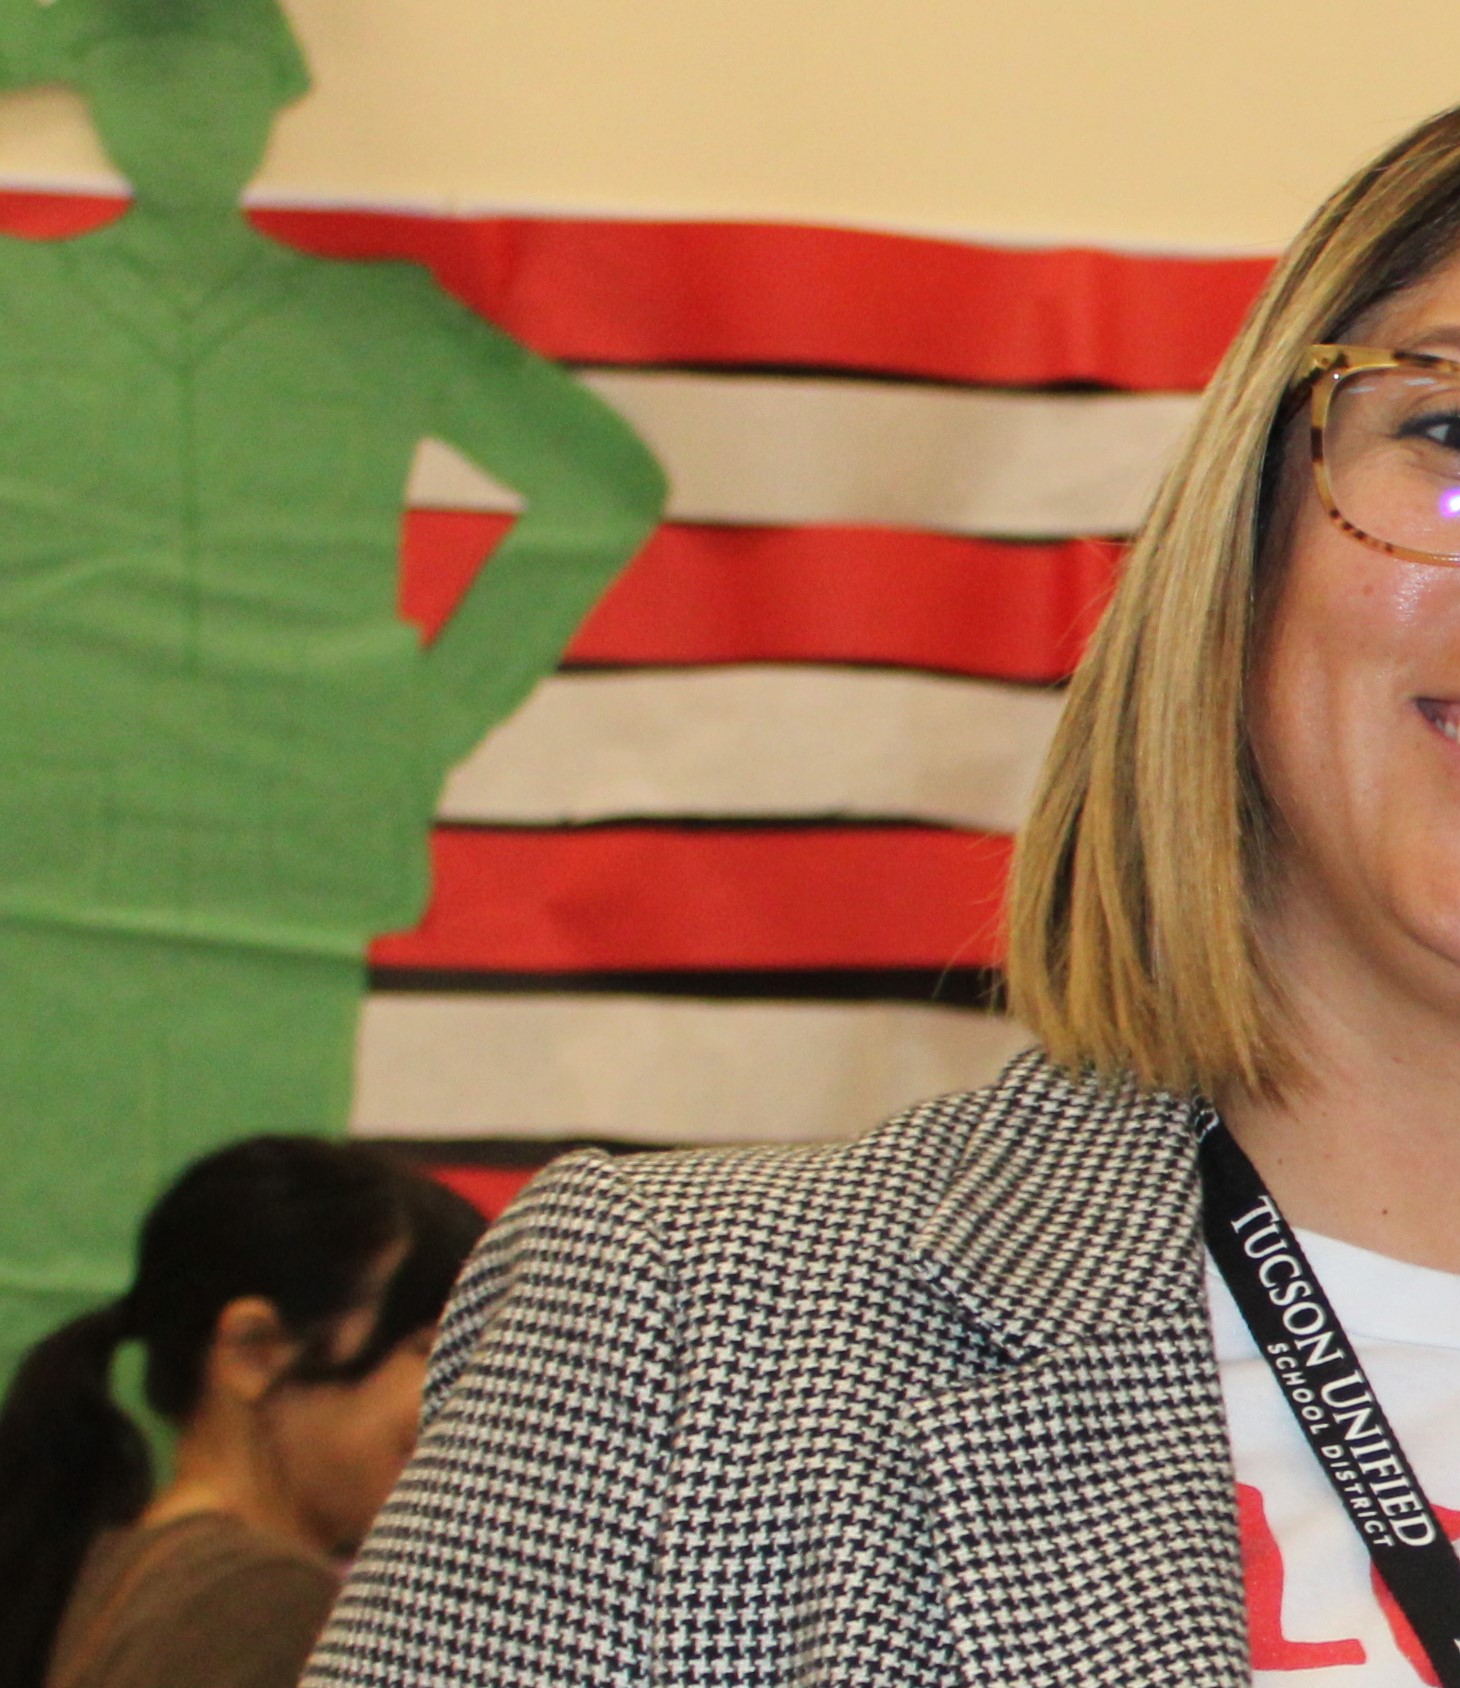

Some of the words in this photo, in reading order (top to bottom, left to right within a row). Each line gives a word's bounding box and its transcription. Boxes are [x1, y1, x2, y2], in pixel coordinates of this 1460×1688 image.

[1231, 1195, 1344, 1368] TUCSON
[1320, 1369, 1437, 1548] UNIFIED
[1267, 1342, 1330, 1436] SCHOOL
[1321, 1443, 1395, 1549] DISTRICT
